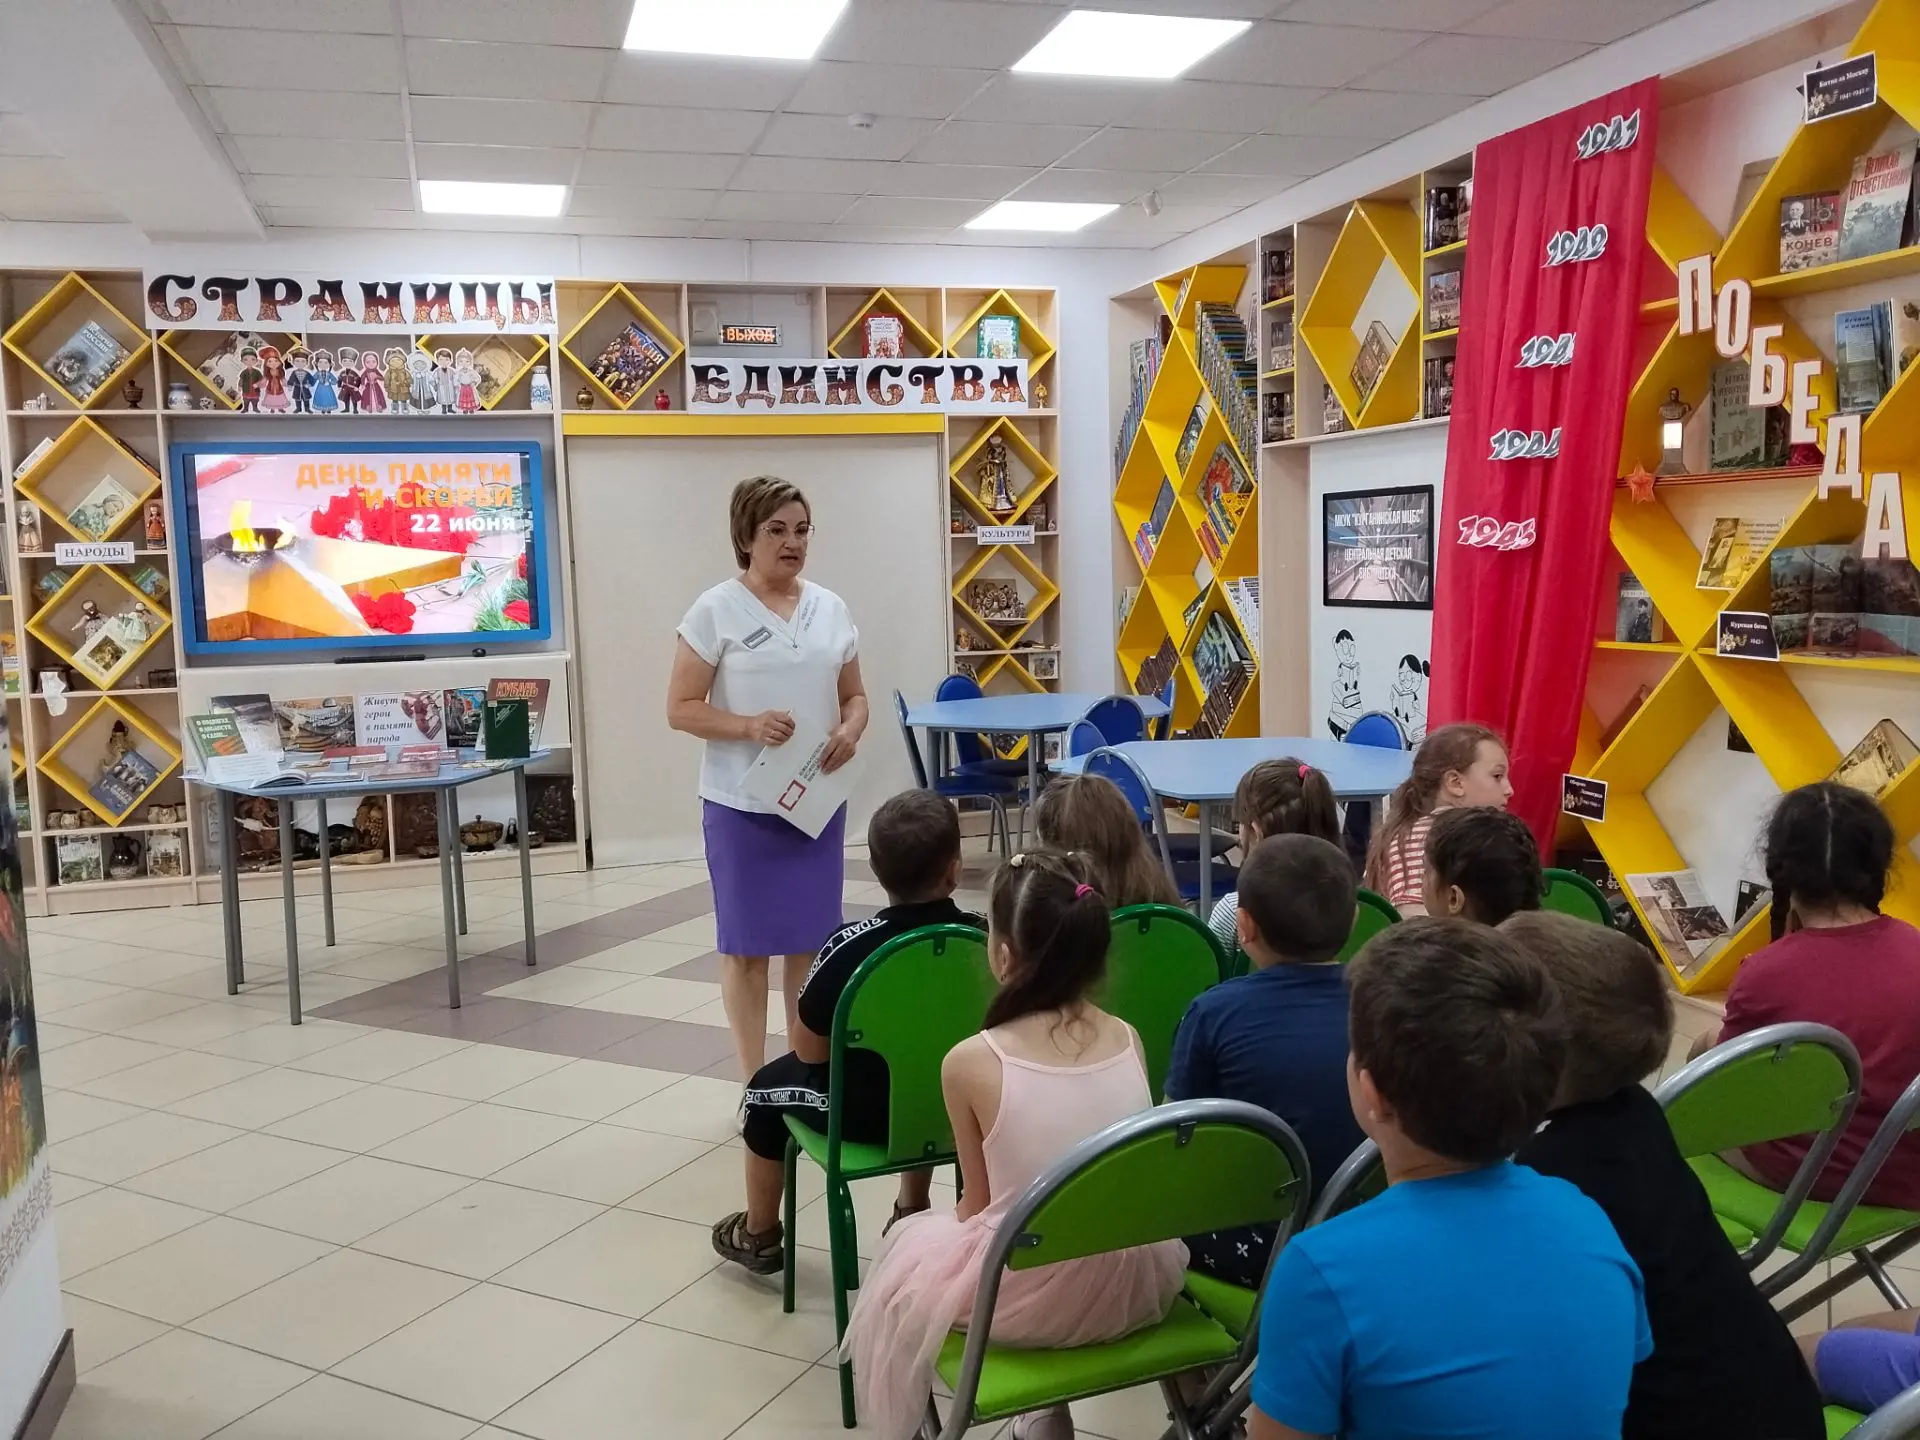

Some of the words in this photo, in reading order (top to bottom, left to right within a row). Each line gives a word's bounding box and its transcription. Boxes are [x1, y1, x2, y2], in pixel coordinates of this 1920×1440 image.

[1573, 108, 1641, 163] 1941
[1540, 223, 1608, 268] 1942
[1785, 237, 1833, 252] КОНЕВ
[147, 273, 557, 331] СТРАНИЦЫ
[726, 327, 775, 343] ВЫХОД
[623, 325, 666, 365] РОССИЯ
[1514, 332, 1576, 369] 194
[690, 363, 1026, 409] ЕДИНСТВА
[1677, 252, 1910, 560] ПОБЕДА
[296, 463, 378, 489] ДЕНЬ
[388, 463, 512, 484] ПАМЯТИ
[363, 488, 384, 509] И
[395, 487, 513, 509] СКОРБИ
[410, 514, 441, 533] 22
[449, 515, 515, 532] июня
[1457, 515, 1537, 551] 1945
[981, 530, 1030, 538] КУЛЬТУРЫ
[64, 547, 125, 558] НАРОДЫ
[1385, 546, 1412, 560] ДЕТСКАЯ
[495, 682, 539, 698] КУБАНЬ
[363, 696, 399, 706] Живут
[364, 710, 391, 719] герои
[373, 721, 413, 730] памяти
[366, 733, 400, 745] народа
